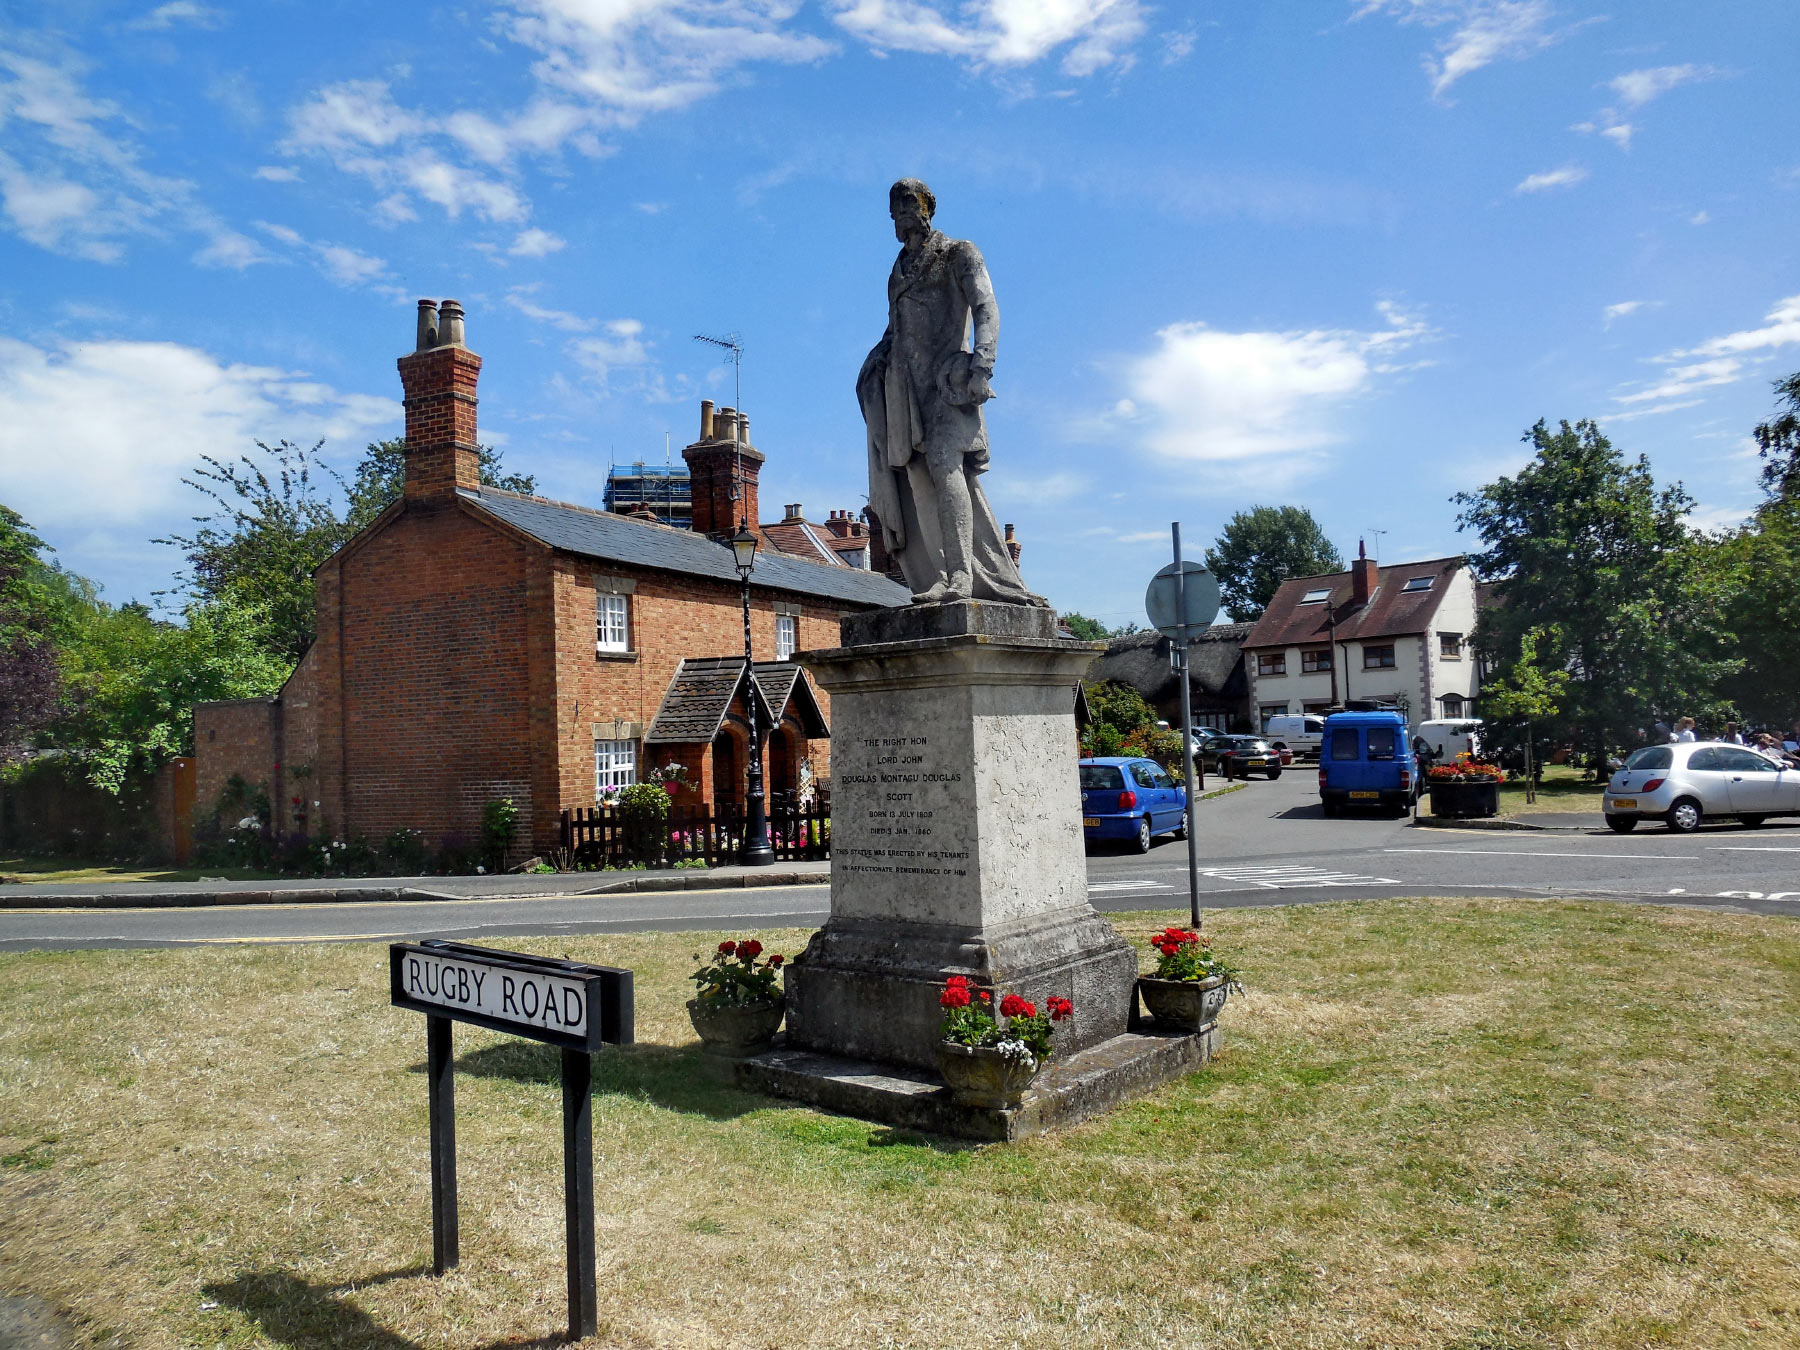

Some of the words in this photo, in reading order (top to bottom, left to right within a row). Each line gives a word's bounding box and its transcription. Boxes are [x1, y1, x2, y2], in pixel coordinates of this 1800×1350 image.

[864, 739, 879, 747] THE
[883, 738, 907, 746] RIGHT
[910, 737, 927, 745] HON
[877, 756, 898, 764] LORD
[901, 756, 923, 764] JOHN
[841, 775, 877, 783] DOUGLAS
[880, 774, 919, 783] MONTAGU
[922, 773, 961, 782] DOUGLAS
[886, 793, 913, 801] SCOTT
[940, 851, 969, 859] TENANTS
[850, 865, 893, 873] AFFECTIONATE
[895, 866, 940, 875] REMEMBRANCE
[410, 958, 486, 1007] RUGBY
[502, 975, 583, 1027] ROAD
